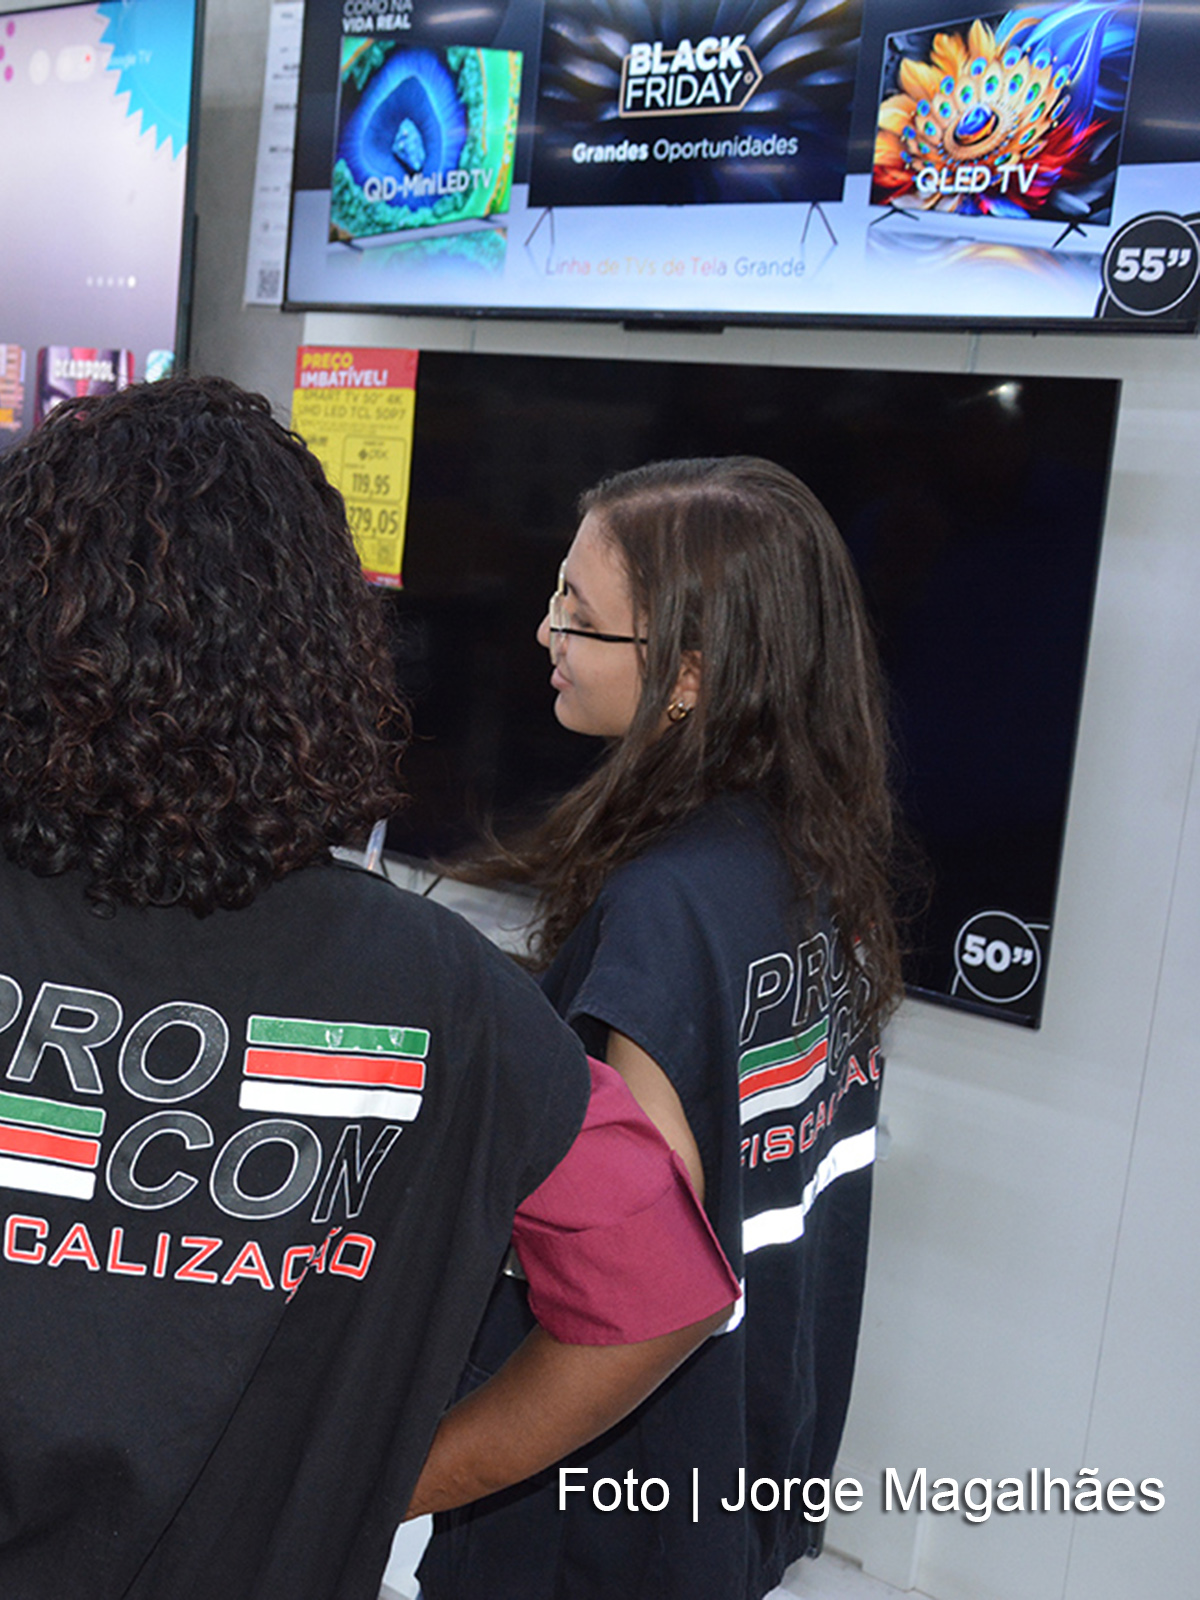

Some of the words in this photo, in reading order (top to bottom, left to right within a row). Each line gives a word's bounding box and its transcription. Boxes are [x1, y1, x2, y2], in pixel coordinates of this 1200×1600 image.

[342, 15, 374, 33] VIDA
[376, 13, 412, 31] REAL
[629, 35, 748, 77] BLACK
[624, 71, 743, 110] FRIDAY
[572, 141, 650, 164] Grandes
[652, 134, 798, 161] Oportunidades
[470, 168, 493, 190] TV
[916, 165, 992, 194] QLED
[997, 163, 1040, 194] TV
[545, 256, 591, 276] Linha
[597, 256, 619, 276] de
[625, 256, 656, 276] TVs
[662, 256, 686, 276] de
[691, 256, 728, 276] Tela
[734, 255, 806, 277] Grande
[53, 358, 117, 383] DEADPOOL
[302, 352, 354, 371] PREÇO
[300, 365, 388, 388] IMBATÍVEL!
[352, 472, 391, 499] 119,95
[105, 1109, 403, 1223] CON
